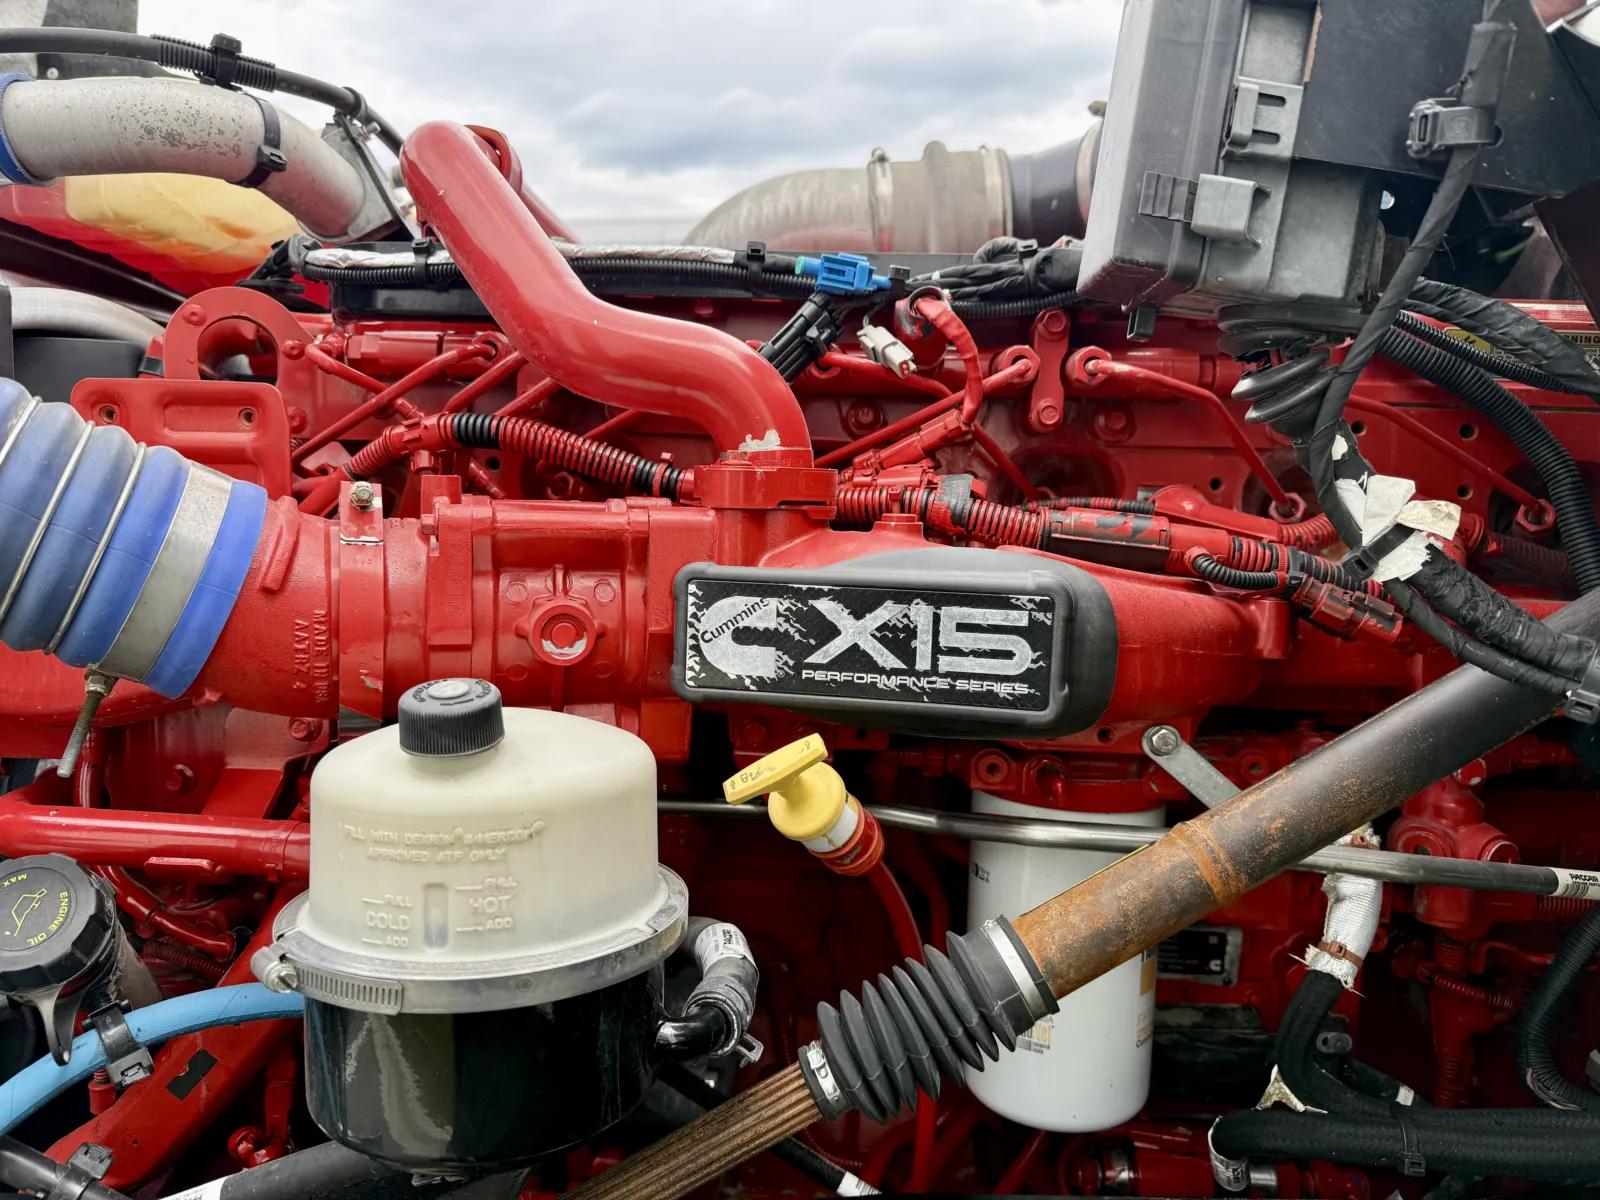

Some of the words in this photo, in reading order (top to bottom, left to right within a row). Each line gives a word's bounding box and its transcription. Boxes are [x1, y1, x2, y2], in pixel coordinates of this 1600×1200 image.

[1569, 334, 1600, 344] NING
[700, 597, 770, 644] Cummins
[313, 609, 329, 656] MADE
[803, 599, 1034, 676] X15
[801, 669, 950, 690] PERFORMANCE
[955, 679, 1030, 695] SERIES
[343, 823, 366, 840] FILL
[370, 829, 399, 844] WITH
[367, 847, 429, 863] APPROVED
[436, 849, 463, 864] ATF
[469, 847, 507, 862] ONLY
[3, 873, 27, 887] MAX
[383, 894, 412, 907] FULL
[469, 895, 511, 914] HOT
[49, 891, 69, 932] ENGINE
[366, 910, 411, 931] COLD
[485, 917, 513, 930] ADD
[27, 932, 47, 945] OIL
[385, 936, 409, 948] ADD
